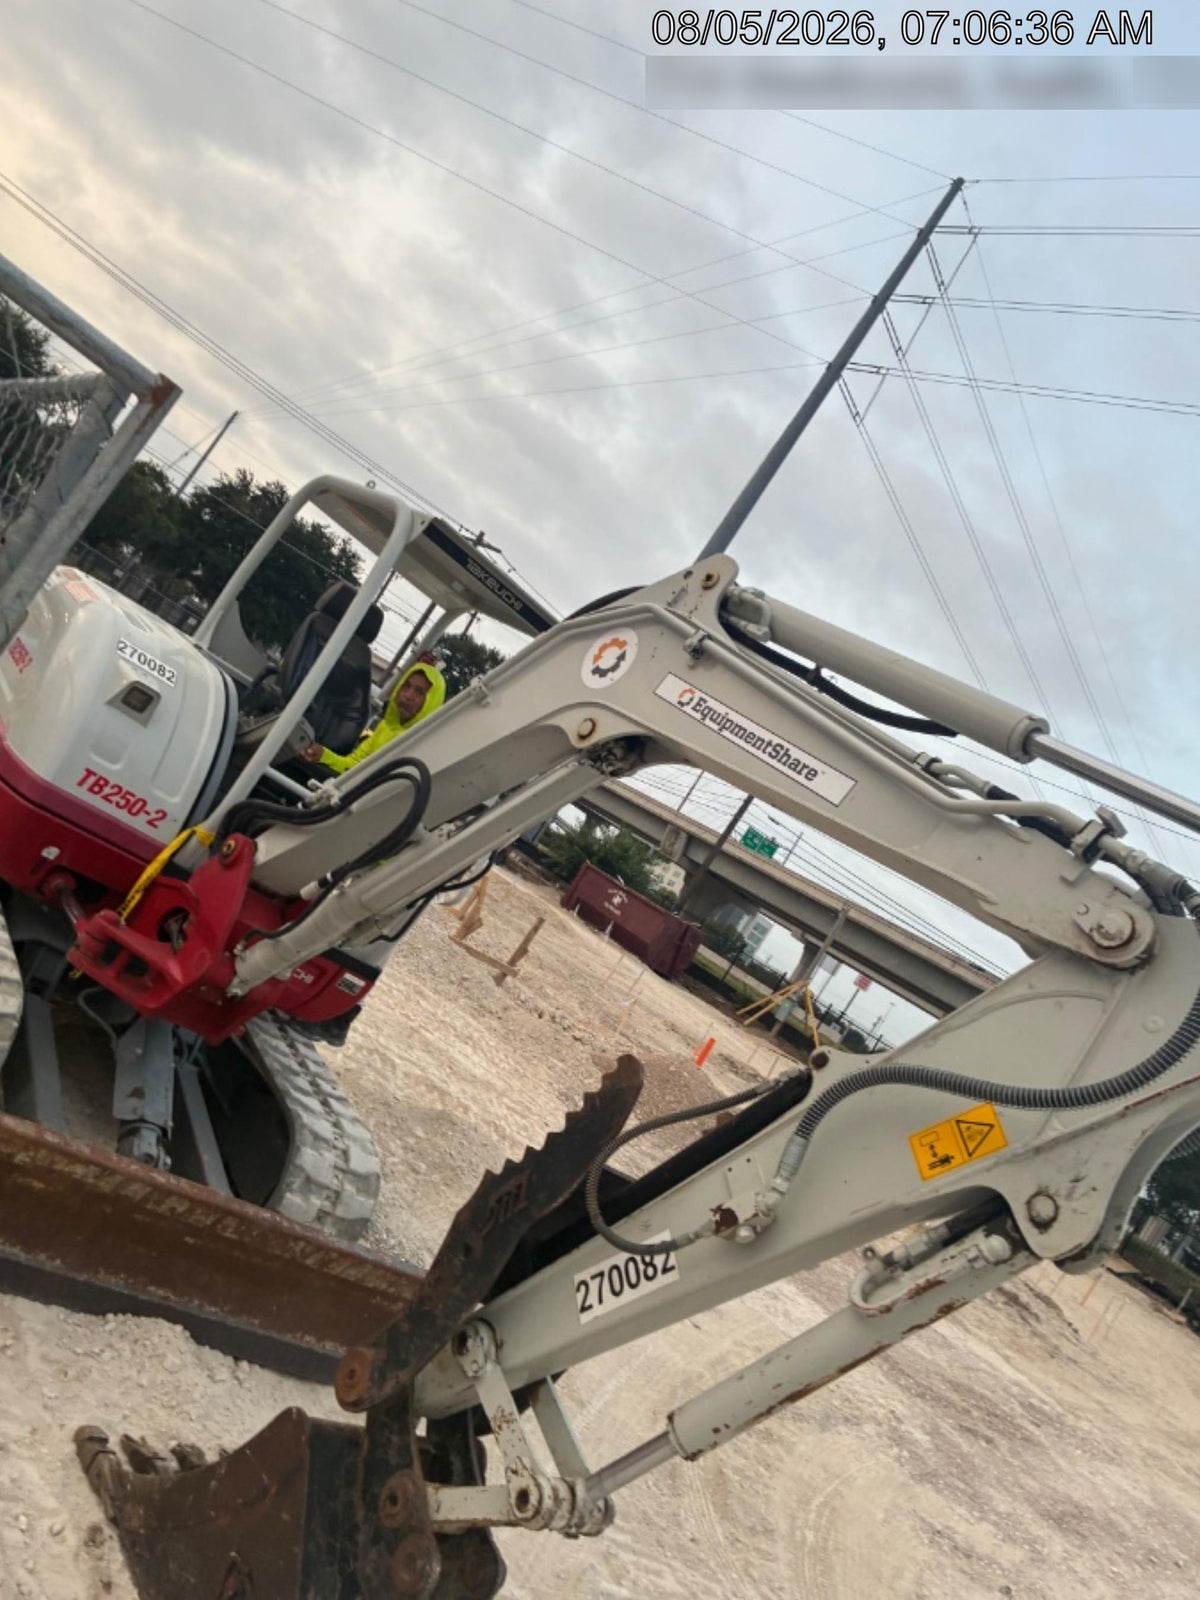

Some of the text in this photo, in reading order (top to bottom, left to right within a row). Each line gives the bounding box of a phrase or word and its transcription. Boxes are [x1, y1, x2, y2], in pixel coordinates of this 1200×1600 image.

[117, 639, 176, 684] 270082
[691, 696, 819, 782] EquipmentShare
[76, 766, 169, 829] TB250-2
[575, 1251, 676, 1314] 270082
